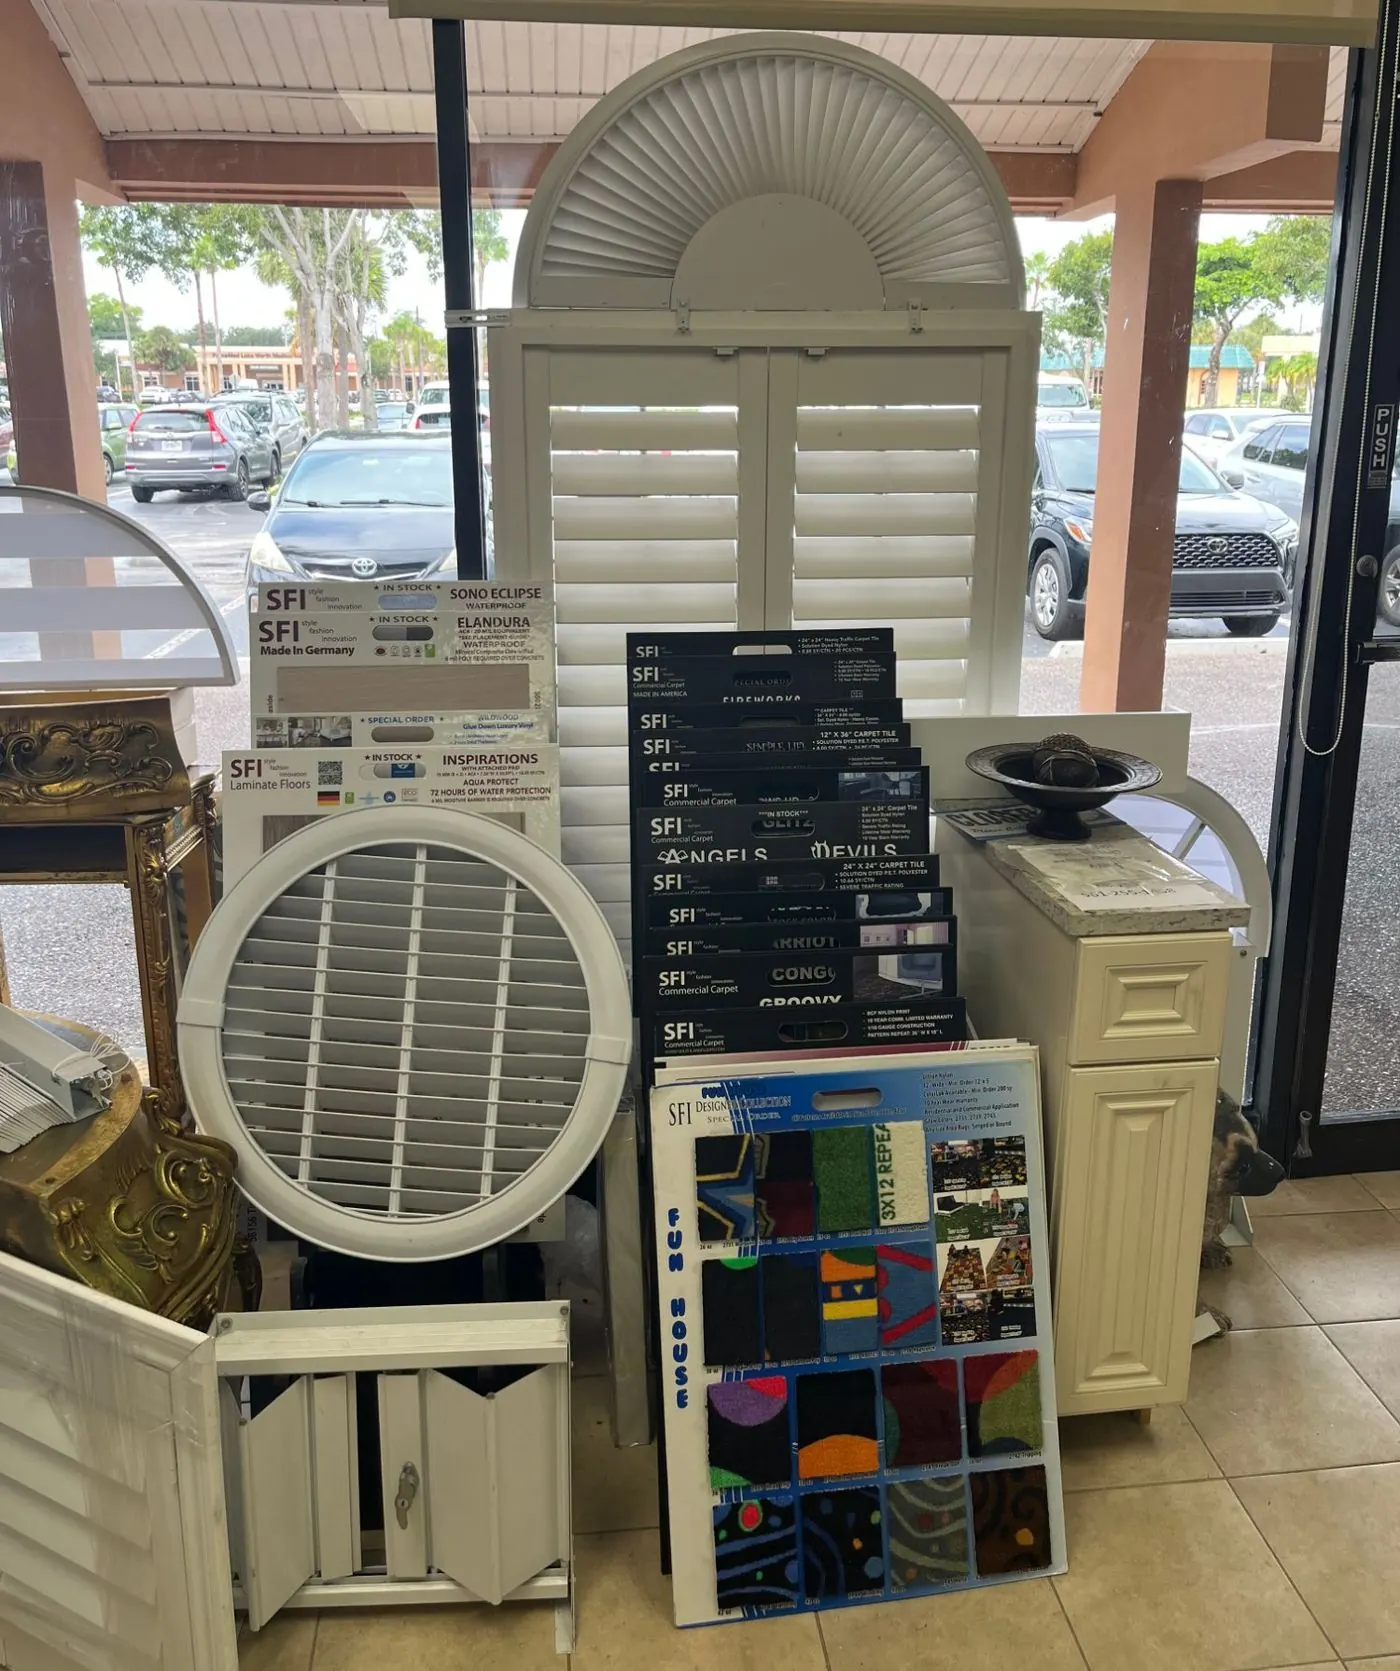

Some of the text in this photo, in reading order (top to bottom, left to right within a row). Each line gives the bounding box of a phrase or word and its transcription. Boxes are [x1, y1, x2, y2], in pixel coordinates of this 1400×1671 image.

[1373, 408, 1390, 467] PUSH
[267, 589, 306, 610] SFI
[450, 588, 541, 600] SONO ECLIPSE
[458, 617, 530, 628] ELANDURA
[260, 621, 298, 642] SFI
[260, 646, 354, 657] Made In Germany
[636, 646, 658, 658] SFI
[632, 666, 658, 682] SFI
[640, 714, 667, 729] SFI
[644, 740, 670, 754] SFI
[442, 754, 538, 766] INSPIRATIONS
[230, 760, 262, 778] SFI
[230, 779, 311, 790] Laminate Floors
[664, 784, 688, 798] SFI
[664, 798, 736, 806] Commercial Carpet
[650, 817, 682, 836] SFI
[653, 874, 682, 890] SFI
[670, 908, 695, 923] SFI
[666, 941, 692, 956] SFI
[658, 971, 685, 986] SFI
[658, 985, 738, 996] Commercial Carpet
[664, 1022, 694, 1040] SFI
[664, 1039, 724, 1048] Commercial Carpet
[992, 1102, 1019, 1110] Application
[668, 1102, 692, 1126] SFI
[747, 1112, 781, 1121] ORDER
[880, 1178, 896, 1220] 3X12
[668, 1208, 688, 1409] FUN HOUSE
